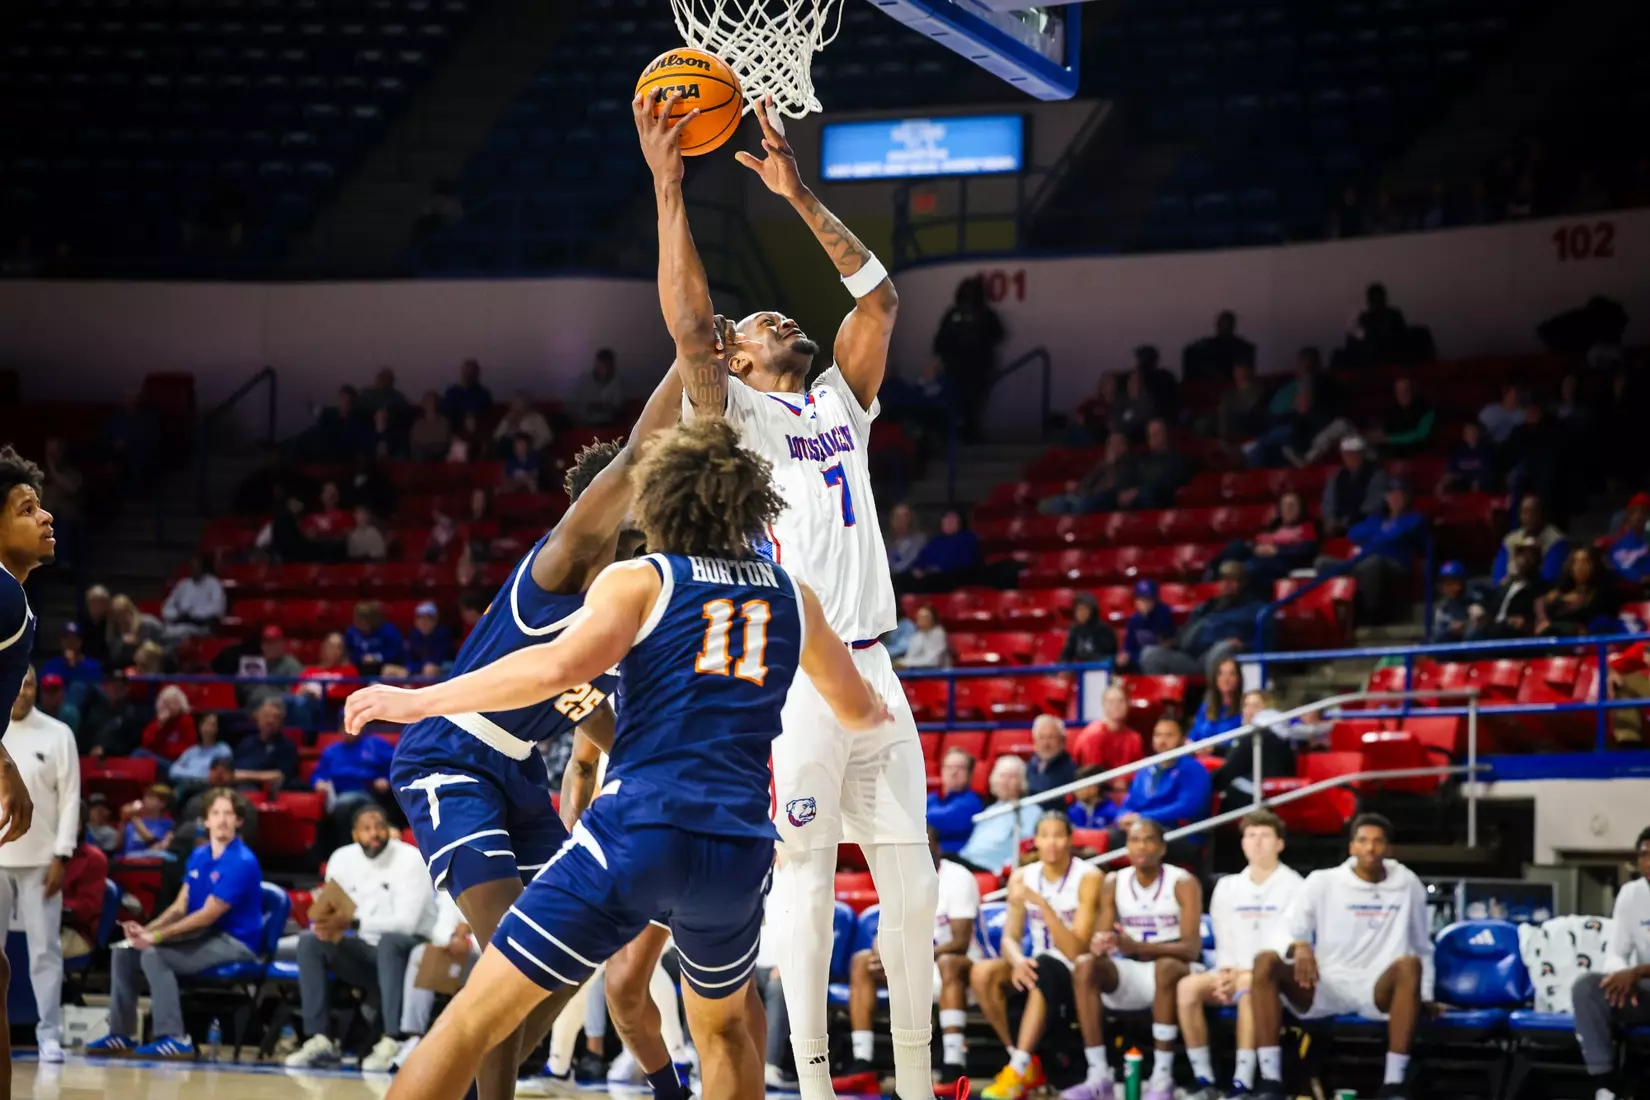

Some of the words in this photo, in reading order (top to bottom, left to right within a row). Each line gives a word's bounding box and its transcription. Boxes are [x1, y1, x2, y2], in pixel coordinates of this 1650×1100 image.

[1551, 220, 1615, 262] 102
[820, 460, 857, 528] 7
[687, 555, 780, 589] HORTON
[694, 598, 772, 687] 11
[553, 681, 606, 722] 25
